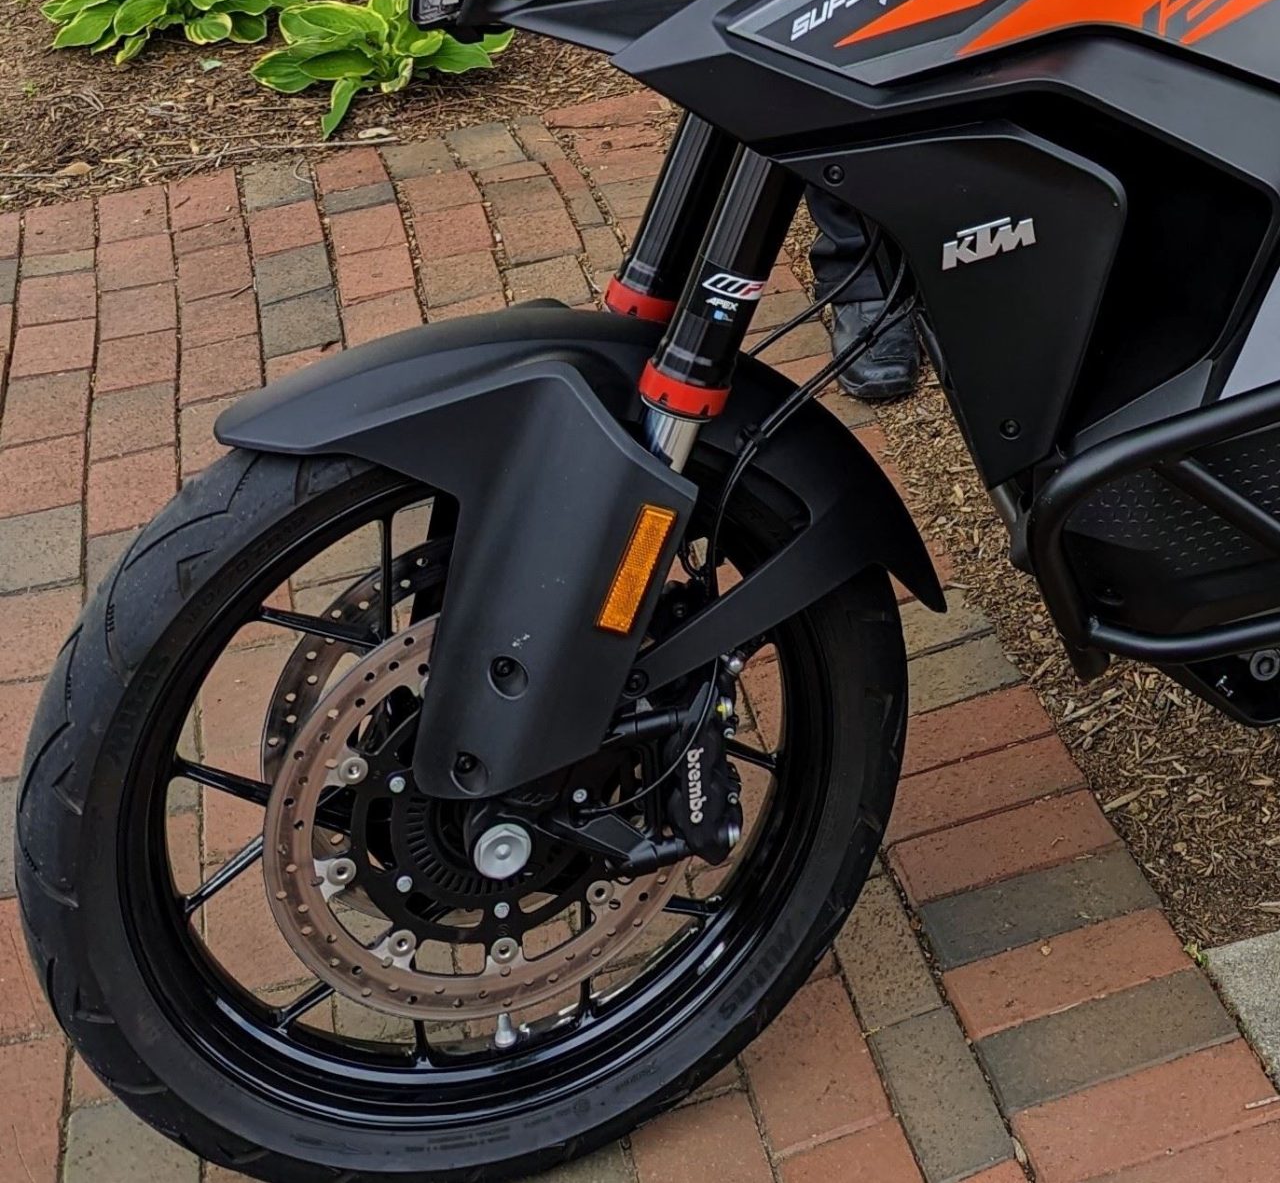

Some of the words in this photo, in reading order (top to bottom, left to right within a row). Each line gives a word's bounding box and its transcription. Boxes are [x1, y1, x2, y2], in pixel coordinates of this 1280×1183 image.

[942, 216, 1037, 271] KTM
[705, 297, 739, 311] APEX
[687, 747, 707, 824] brembo
